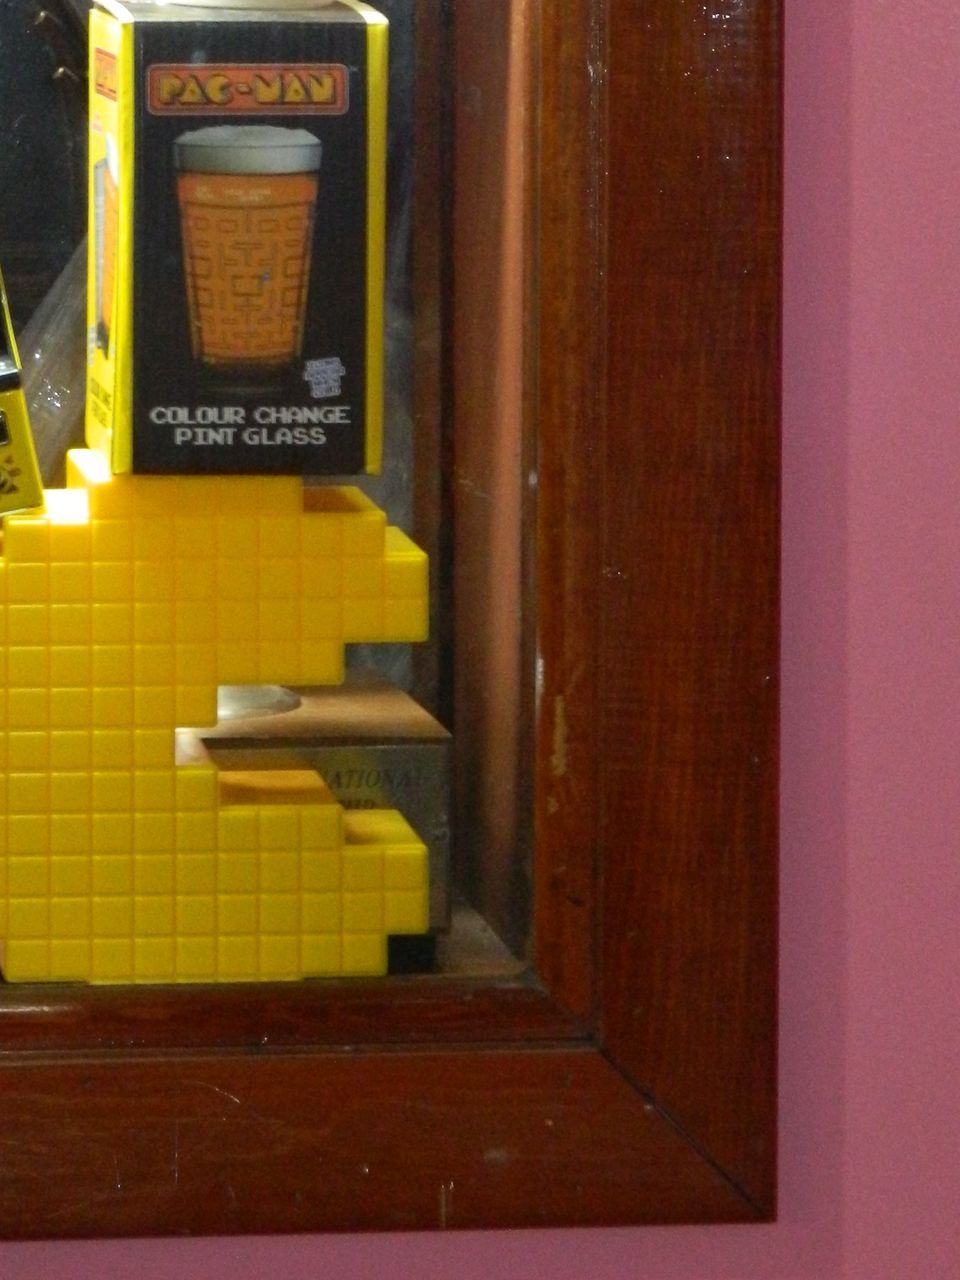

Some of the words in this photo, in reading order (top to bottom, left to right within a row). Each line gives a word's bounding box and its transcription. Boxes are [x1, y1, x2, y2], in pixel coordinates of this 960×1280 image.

[159, 73, 336, 105] PAC-MAN
[150, 406, 246, 425] COLOUR
[253, 406, 351, 424] CHANGE
[174, 427, 238, 446] PINT
[242, 427, 327, 446] GLASS
